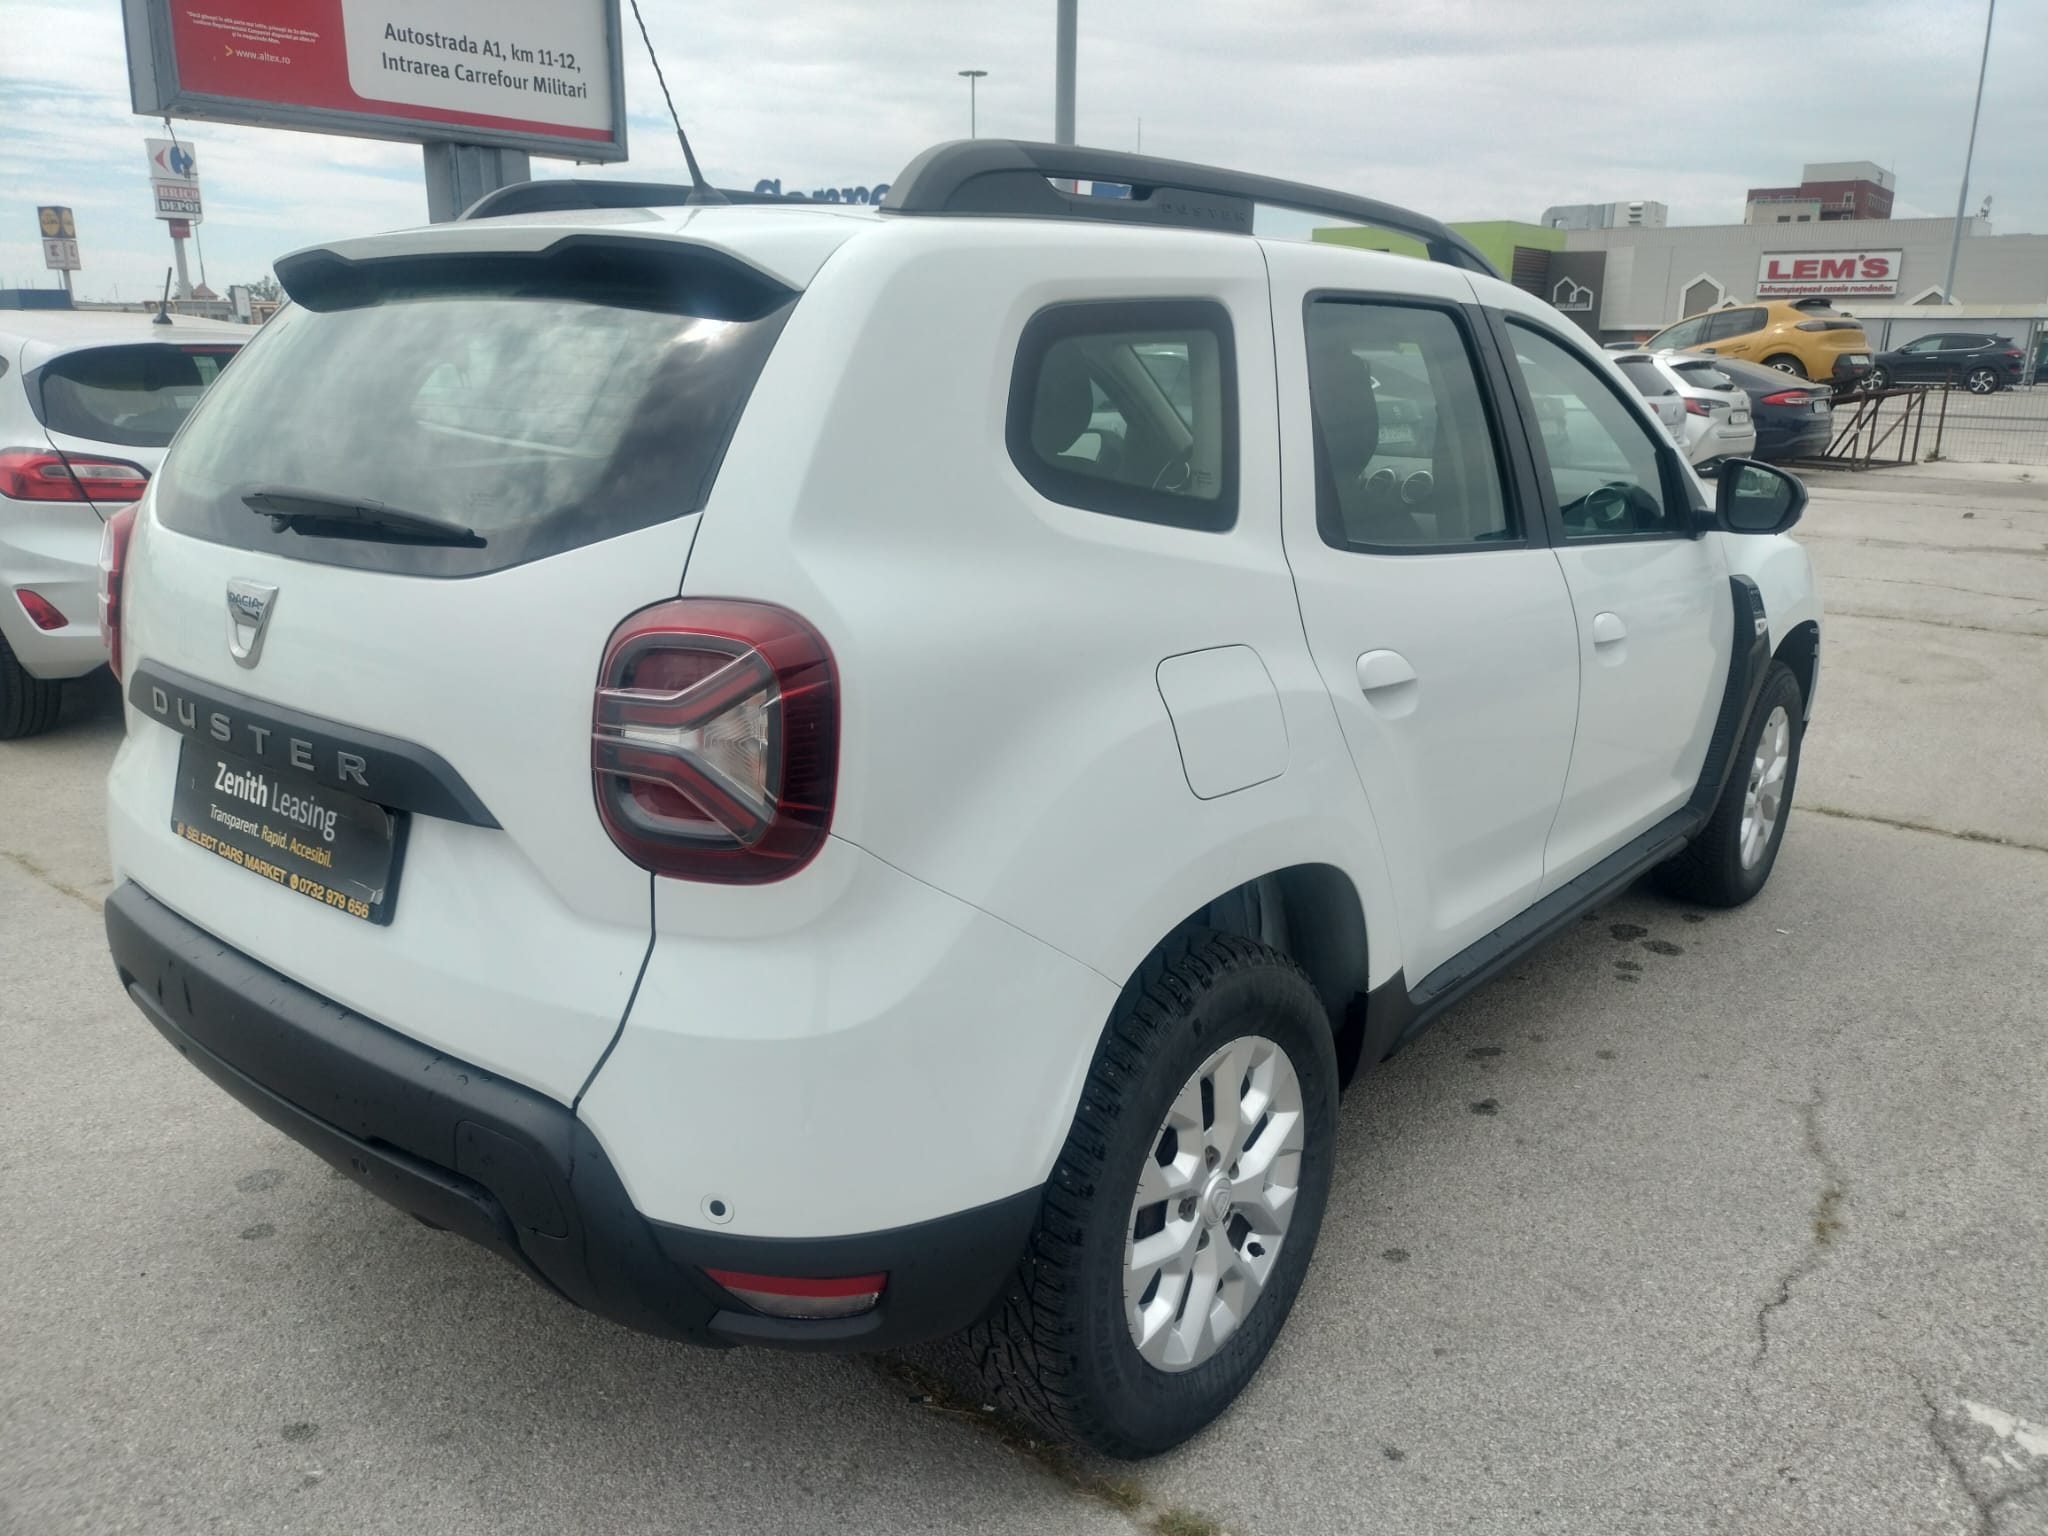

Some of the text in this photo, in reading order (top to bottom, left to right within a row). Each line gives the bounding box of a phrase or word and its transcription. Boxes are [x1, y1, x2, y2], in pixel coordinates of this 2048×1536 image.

[235, 48, 291, 64] www.altex.ro
[382, 52, 587, 99] Intrarea Carrefour Militari
[384, 23, 581, 73] Autostrada A1, km 11-12,
[151, 685, 370, 787] DUSTER
[214, 761, 337, 842] Zenith Leasing
[210, 803, 332, 868] Transparent. Rapid. Accesibil.
[186, 827, 369, 919] SELECT CARS MARKET 0732 979 656
